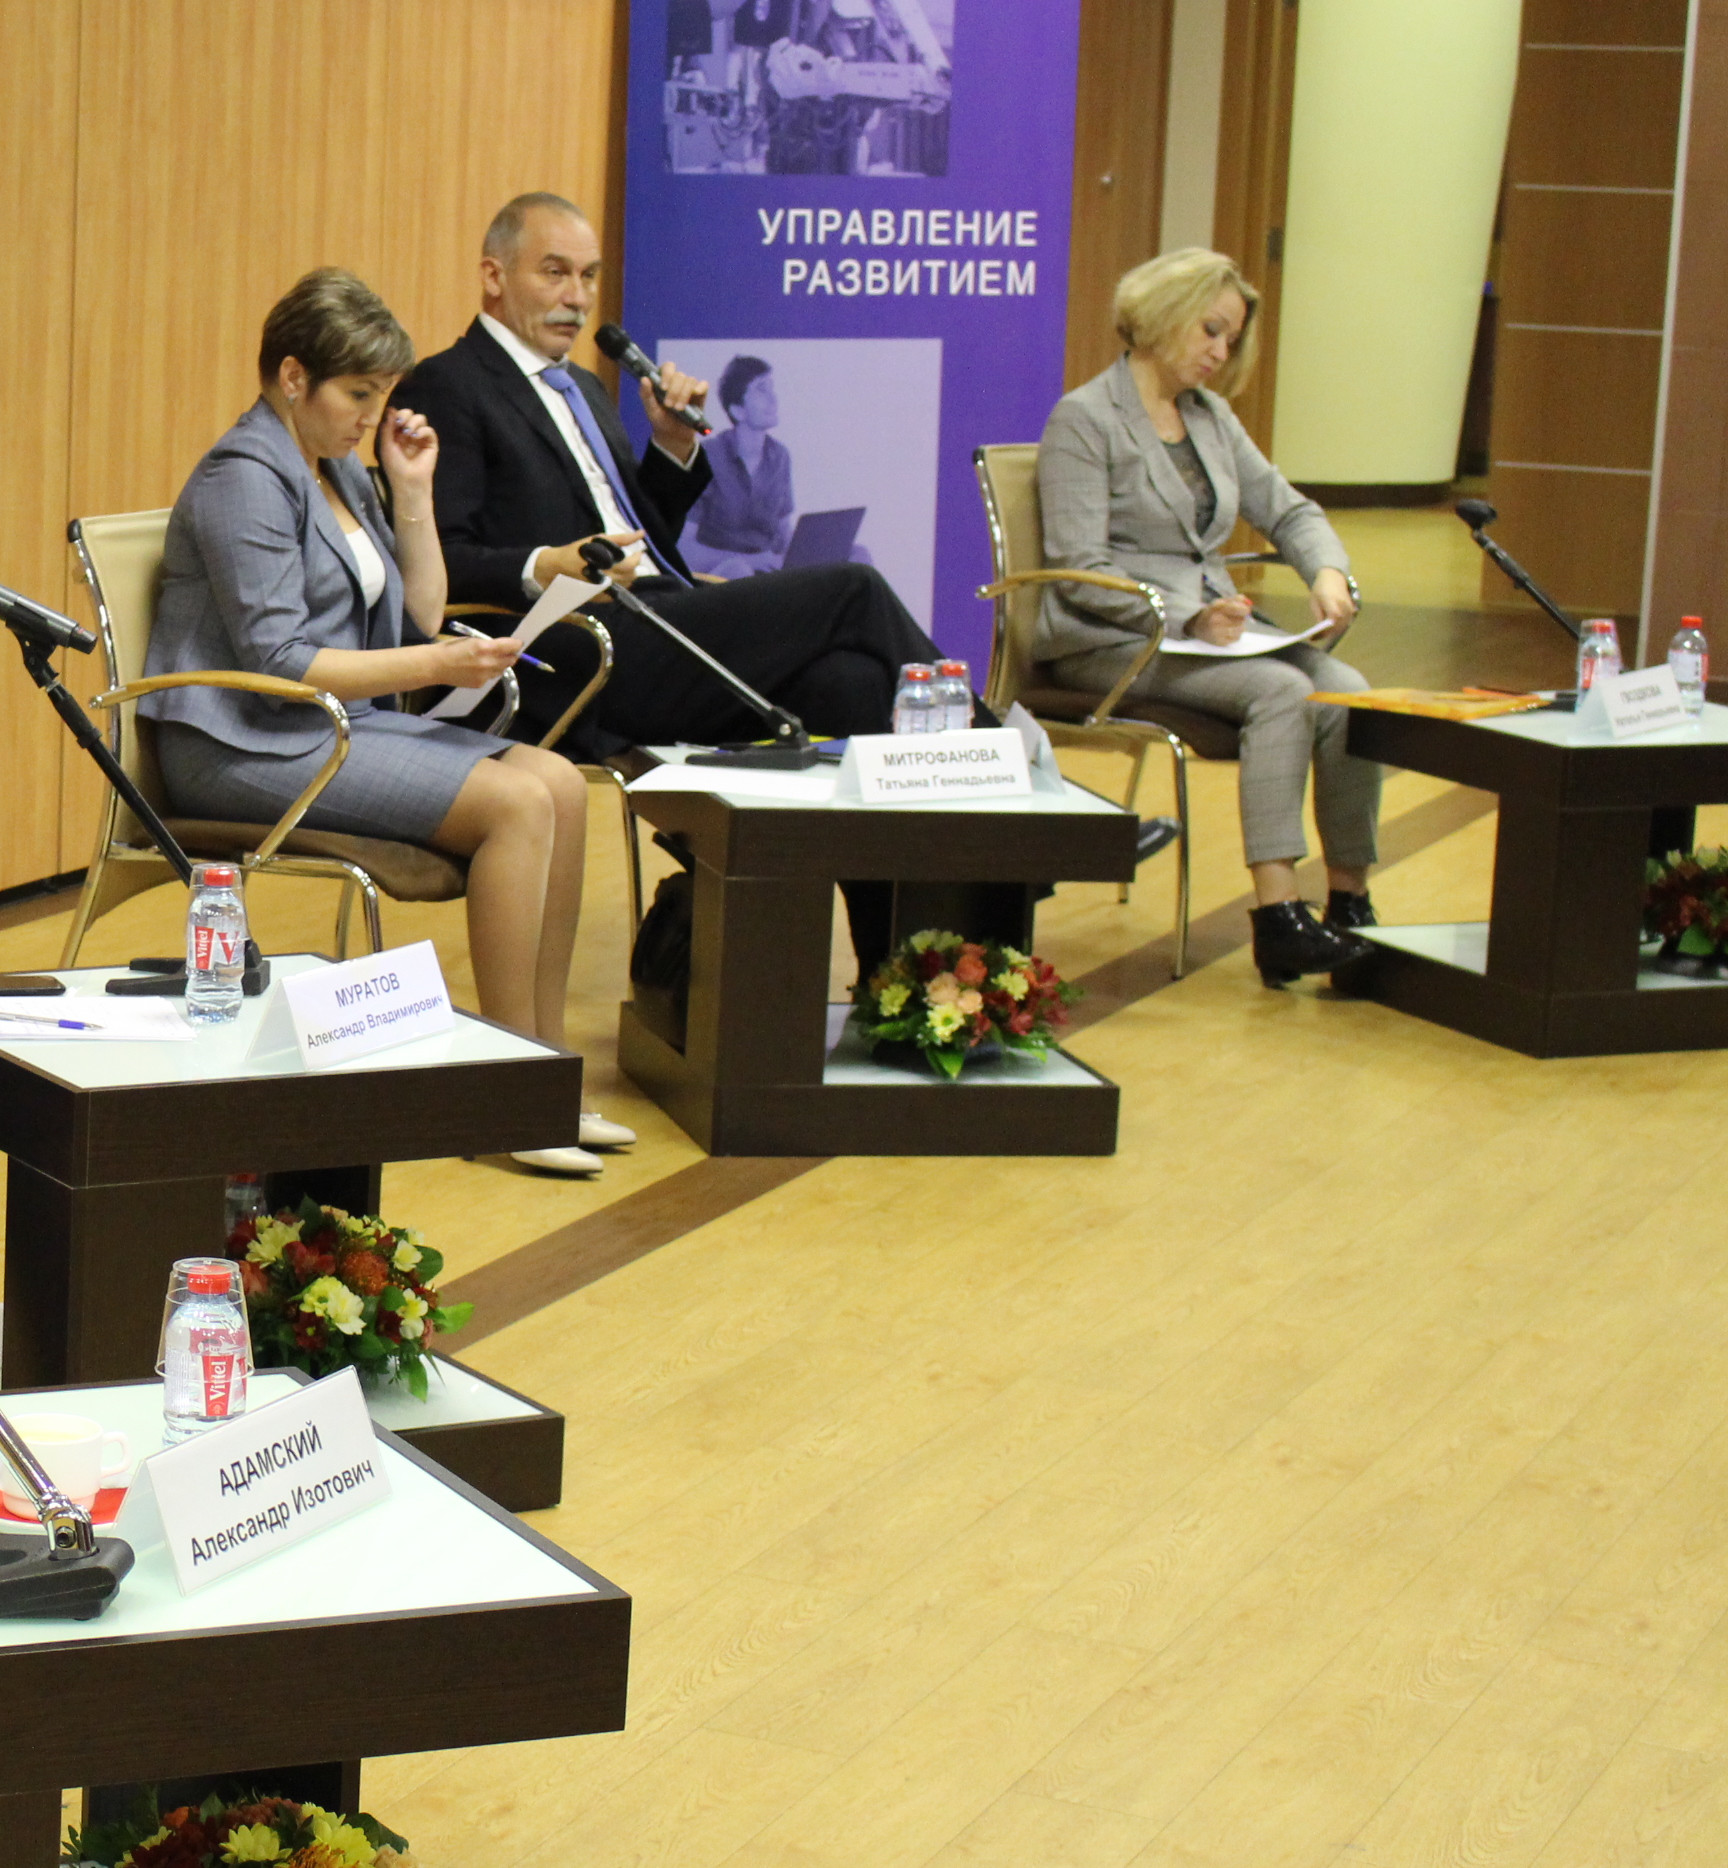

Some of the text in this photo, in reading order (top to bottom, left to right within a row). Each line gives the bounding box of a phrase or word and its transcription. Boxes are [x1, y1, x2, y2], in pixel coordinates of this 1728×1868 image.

[758, 208, 1038, 246] УПРАВЛЕНИЕ
[782, 259, 1036, 296] РАЗВИТИЕМ
[884, 748, 1000, 766] МИТРОФАНОВА
[876, 773, 1016, 790] Татьяна Геннадьевна
[196, 930, 209, 959] Vittel
[335, 972, 400, 1008] МУРАТОВ
[307, 993, 444, 1048] Александр Владимирович
[209, 1361, 227, 1401] Vittel
[219, 1420, 323, 1497] АДАМСКИЙ
[191, 1459, 376, 1566] Александр Изотович
